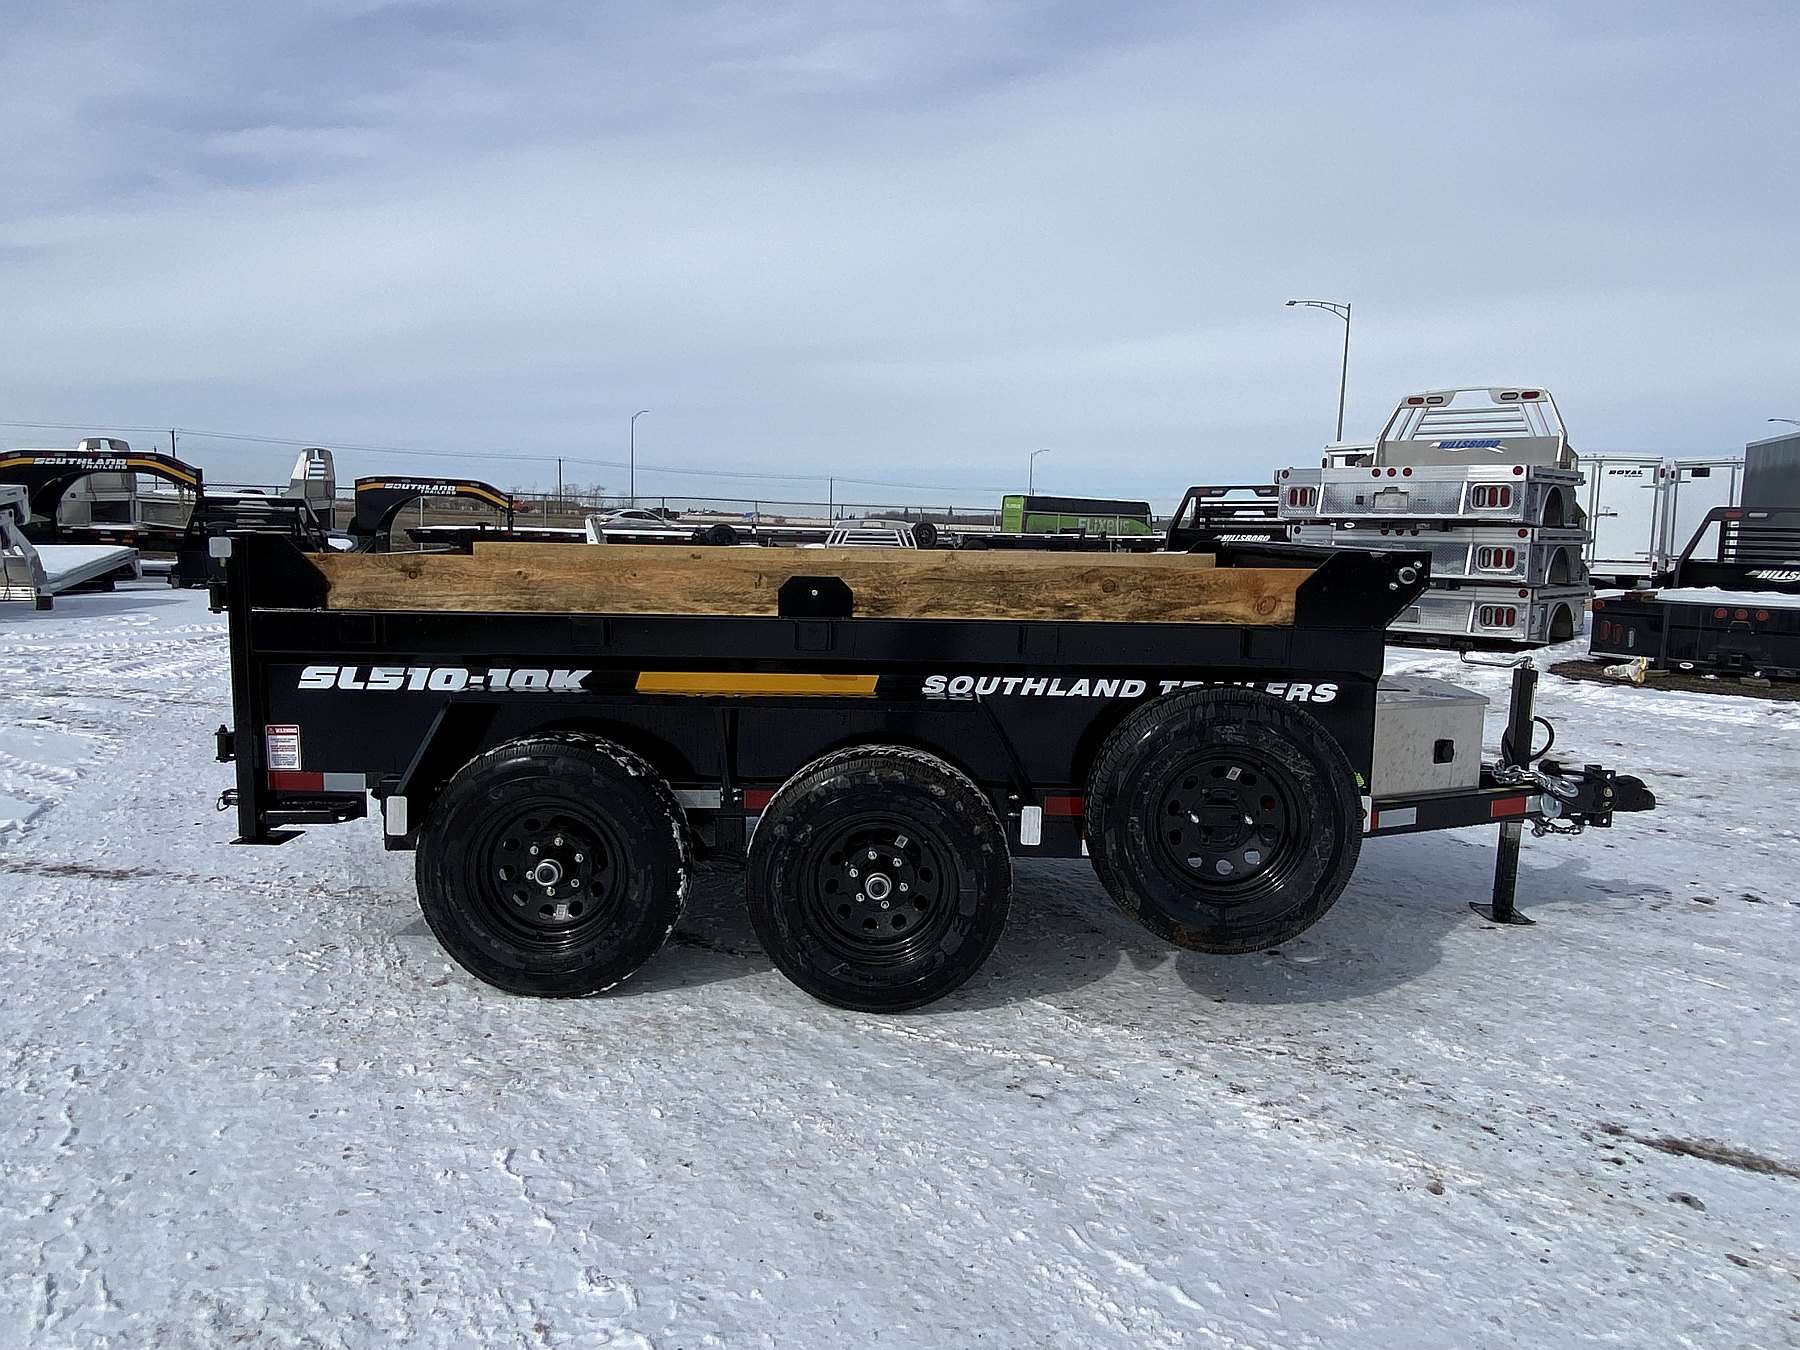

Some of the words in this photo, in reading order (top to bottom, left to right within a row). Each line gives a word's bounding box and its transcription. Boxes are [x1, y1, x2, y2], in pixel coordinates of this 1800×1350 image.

[33, 457, 127, 465] SOUTHLAND
[384, 482, 456, 492] SOUTHLAND
[1220, 534, 1271, 543] HILLSBORO
[1756, 569, 1800, 580] HILLS
[297, 665, 592, 692] SL510-10K
[921, 674, 1147, 699] SOUTHLAND
